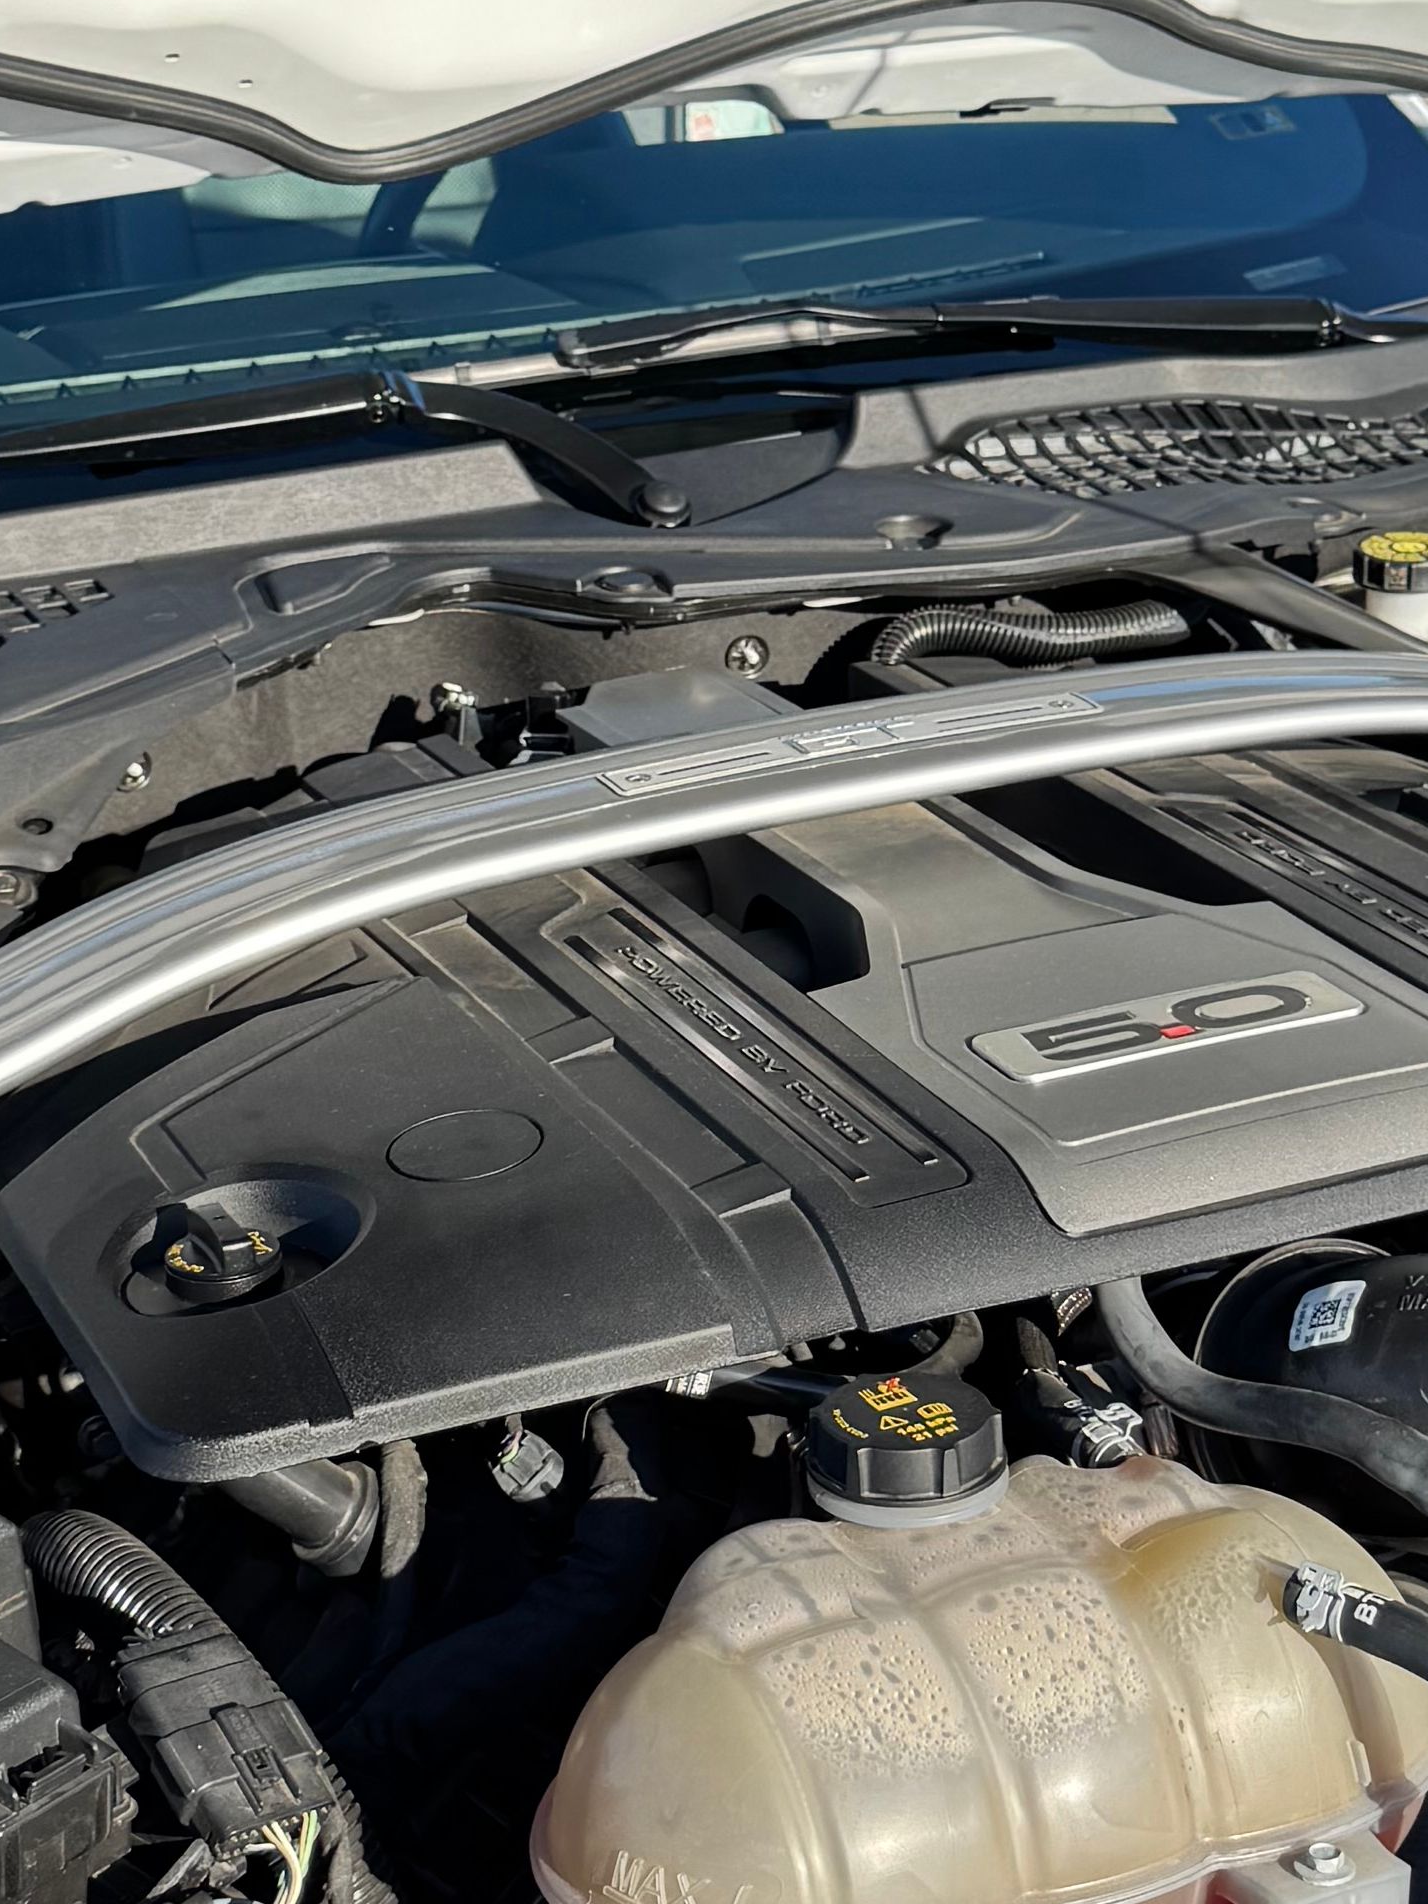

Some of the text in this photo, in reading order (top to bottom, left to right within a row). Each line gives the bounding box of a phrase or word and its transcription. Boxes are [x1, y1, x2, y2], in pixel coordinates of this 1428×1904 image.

[615, 945, 870, 1145] POWERED BY FORD
[1020, 984, 1313, 1062] 5.0
[934, 1423, 960, 1437] psi
